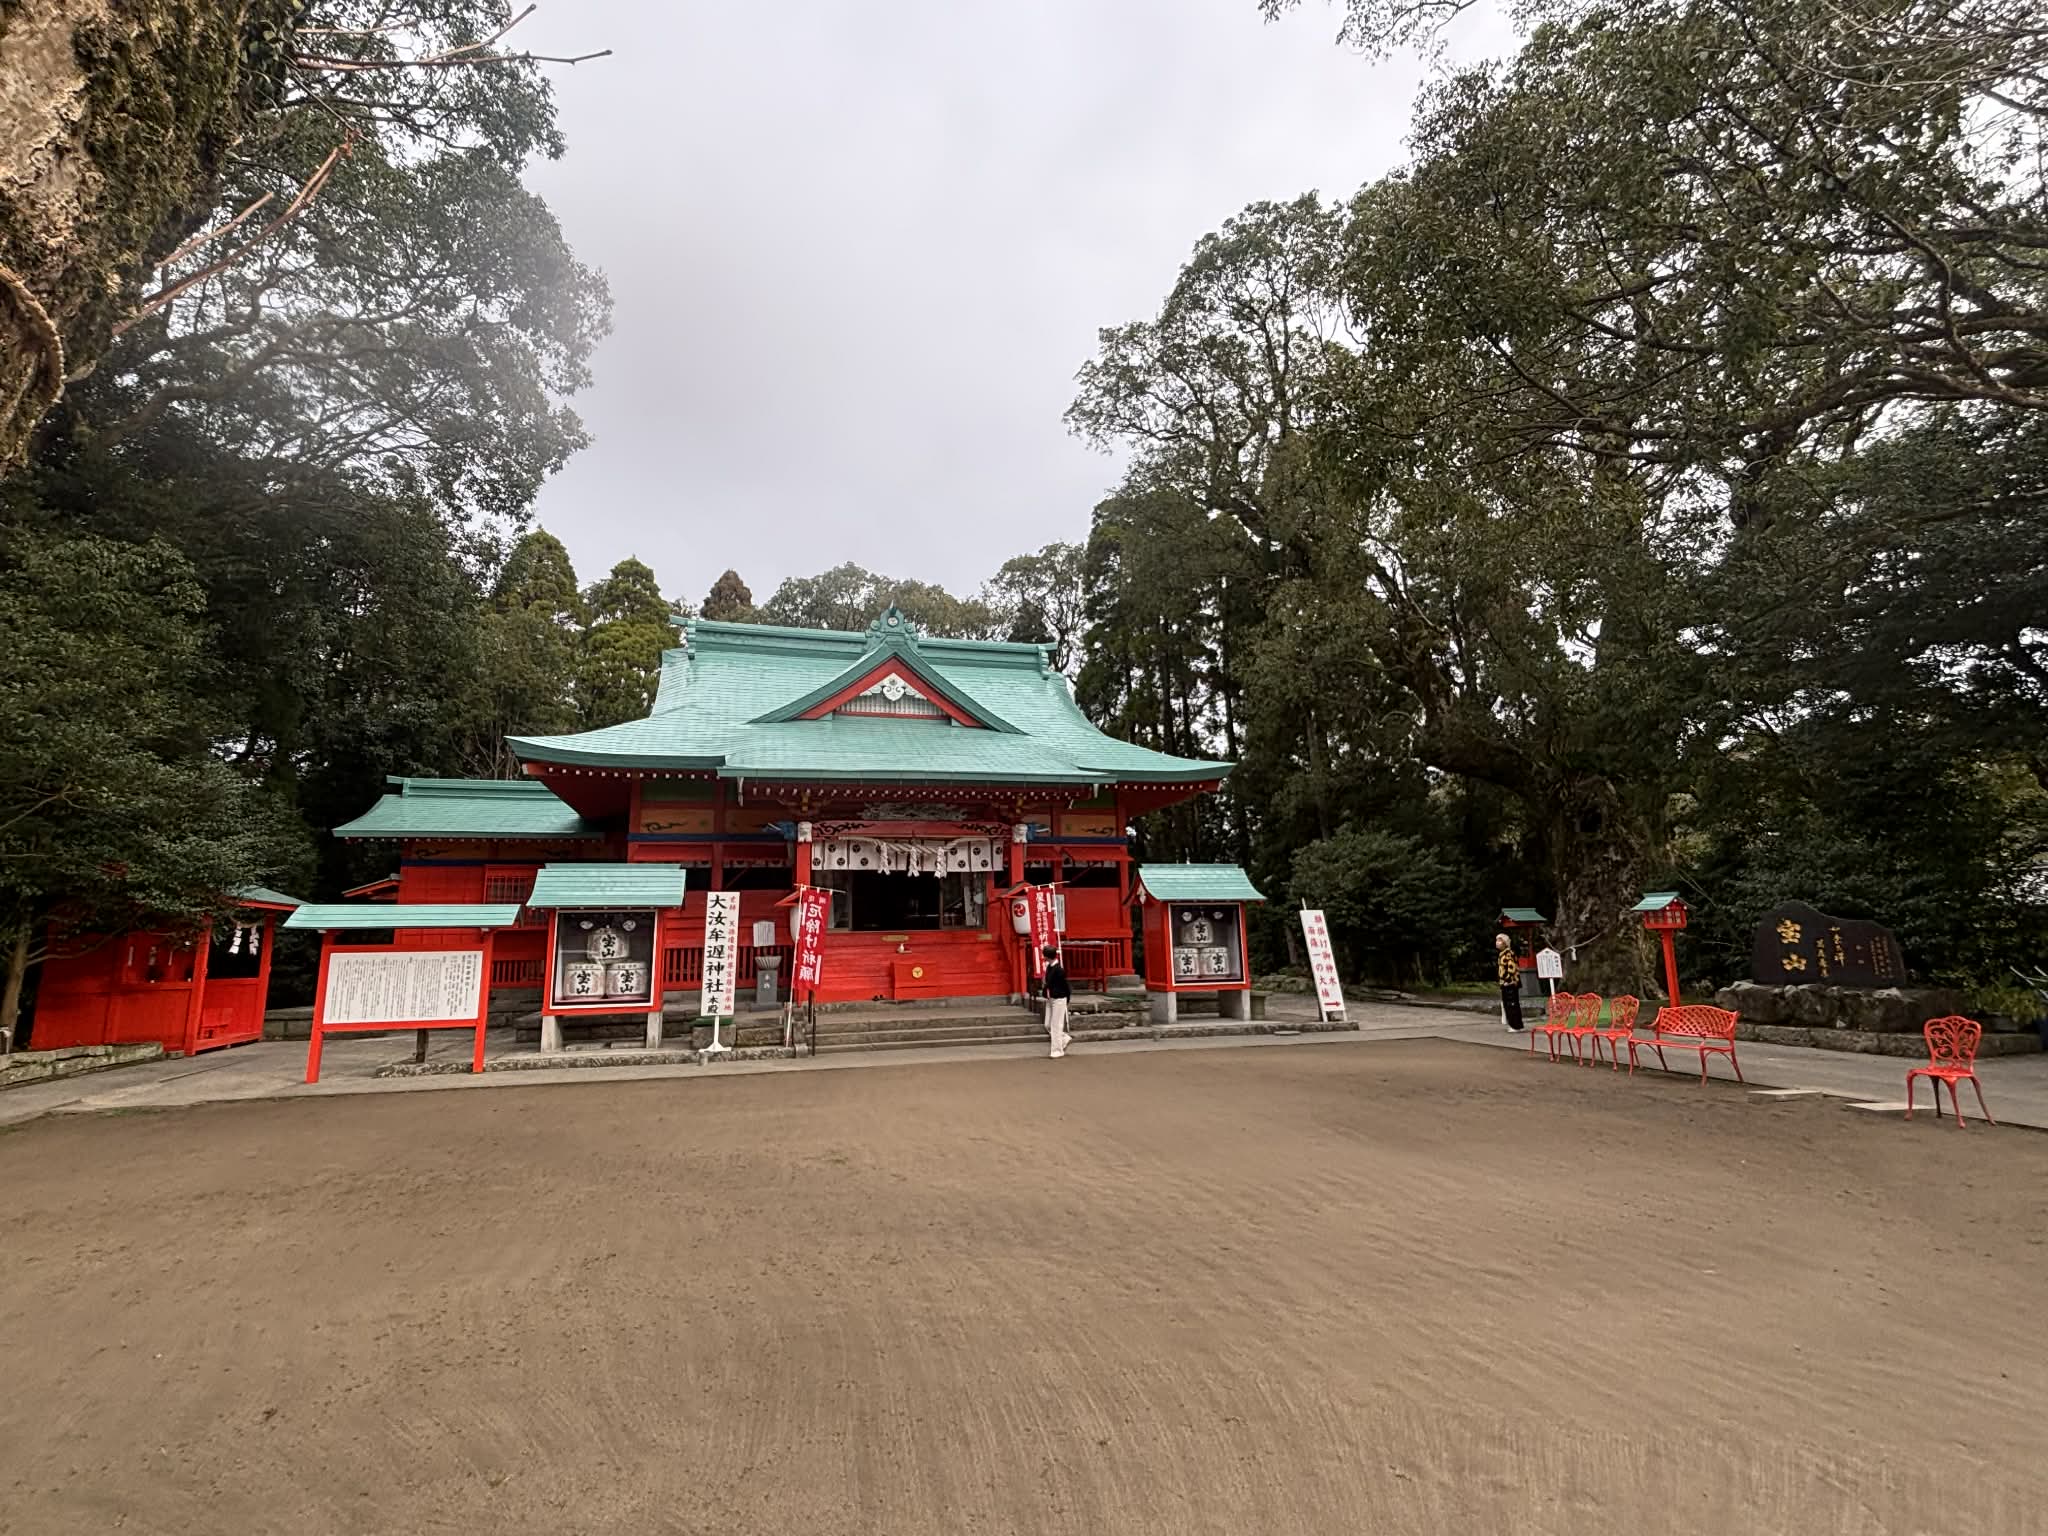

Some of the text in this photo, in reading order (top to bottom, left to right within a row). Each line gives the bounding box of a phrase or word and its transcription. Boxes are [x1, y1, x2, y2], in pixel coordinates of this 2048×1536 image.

[799, 904, 822, 981] 厄除け祈願
[1195, 922, 1207, 942] 宝山
[601, 934, 616, 957] 宝山
[1776, 919, 1807, 971] 宝山
[1181, 954, 1193, 974] 宝山
[1213, 953, 1224, 973] 宝山
[576, 970, 591, 994] 宝山
[619, 969, 634, 993] 宝山
